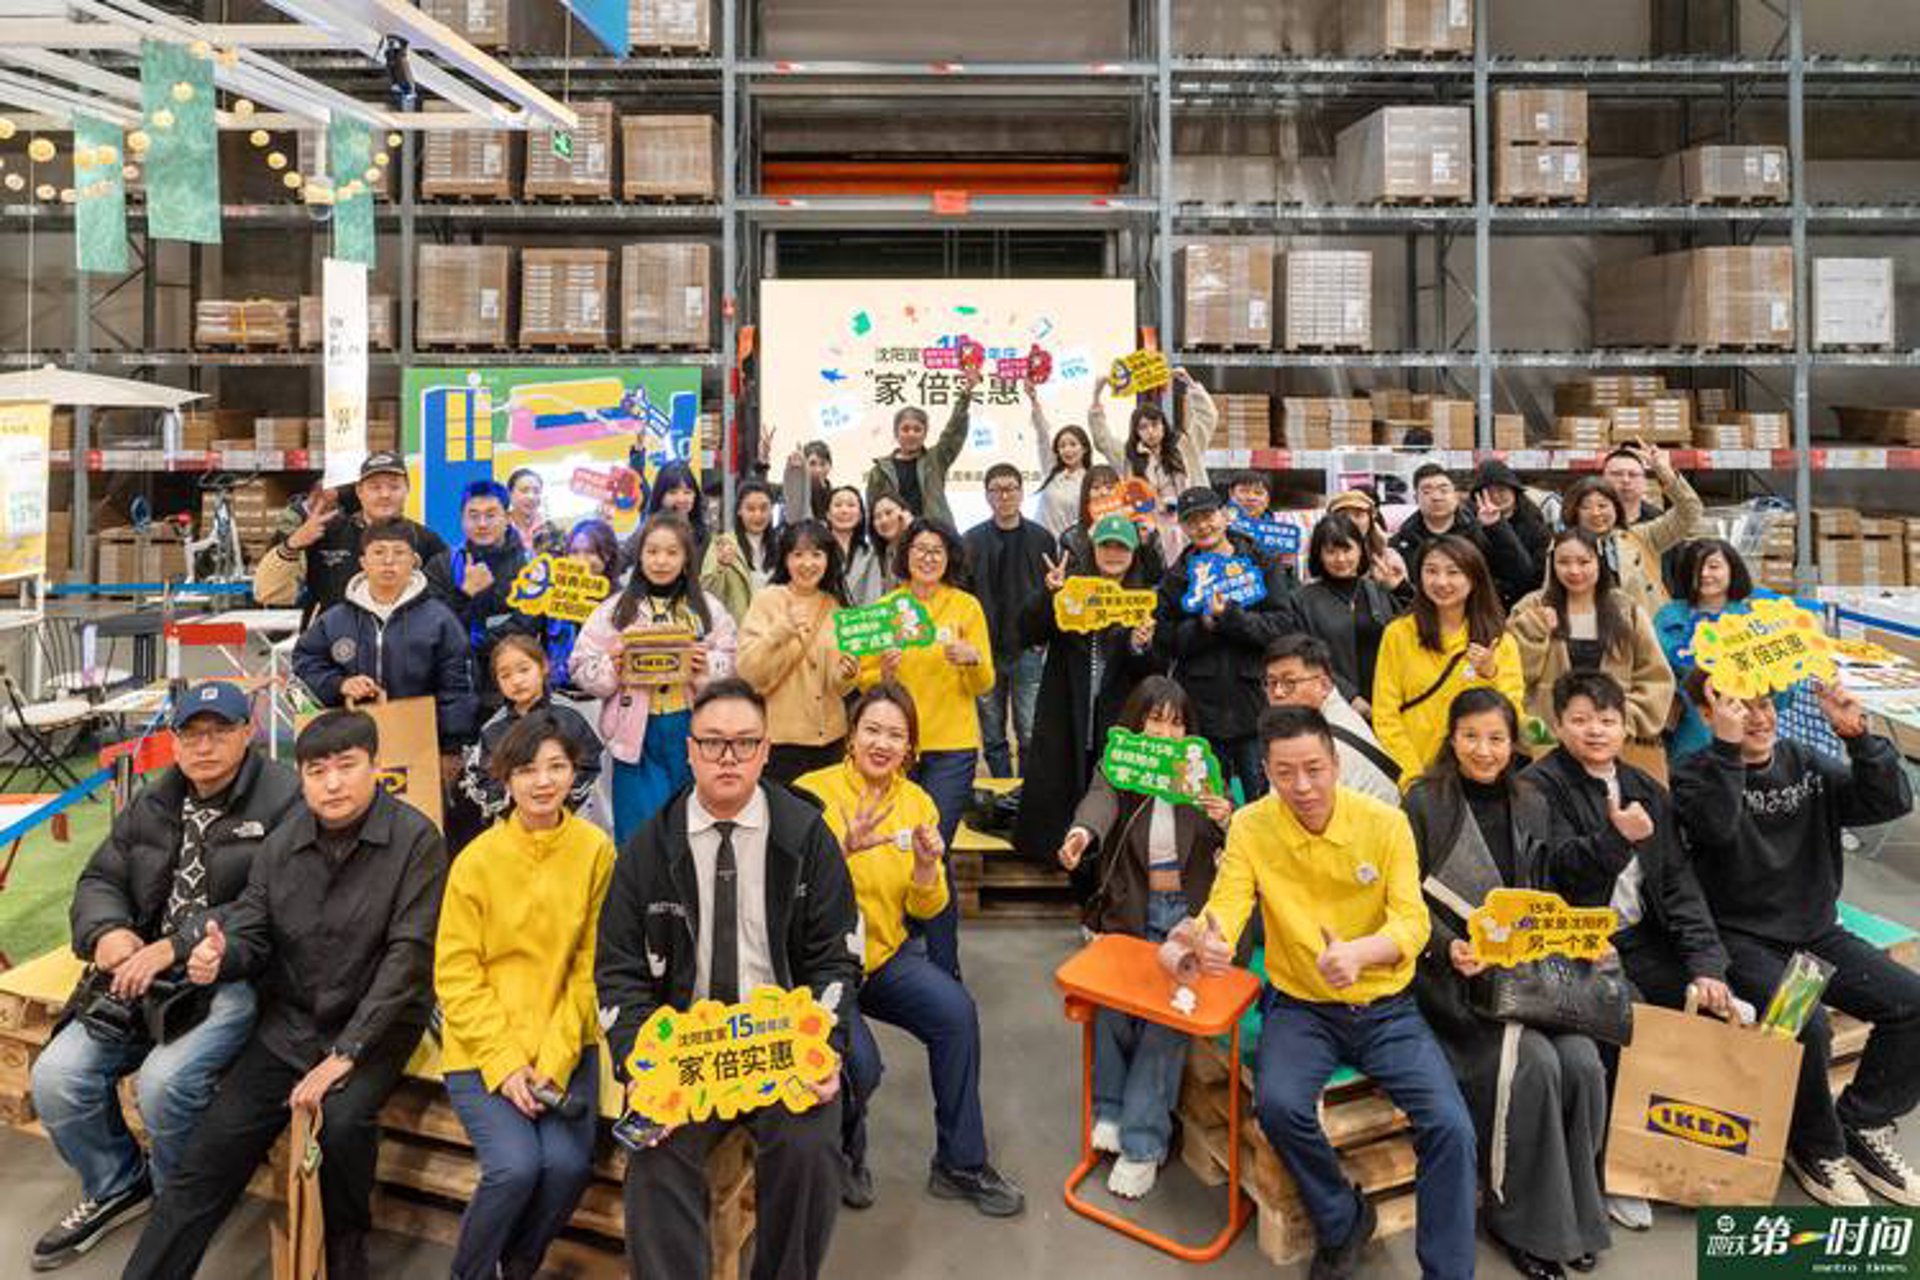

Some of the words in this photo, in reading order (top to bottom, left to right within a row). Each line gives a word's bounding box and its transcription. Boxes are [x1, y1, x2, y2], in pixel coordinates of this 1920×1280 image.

[1528, 933, 1600, 951] 另一个家
[1661, 1108, 1738, 1140] IKEA
